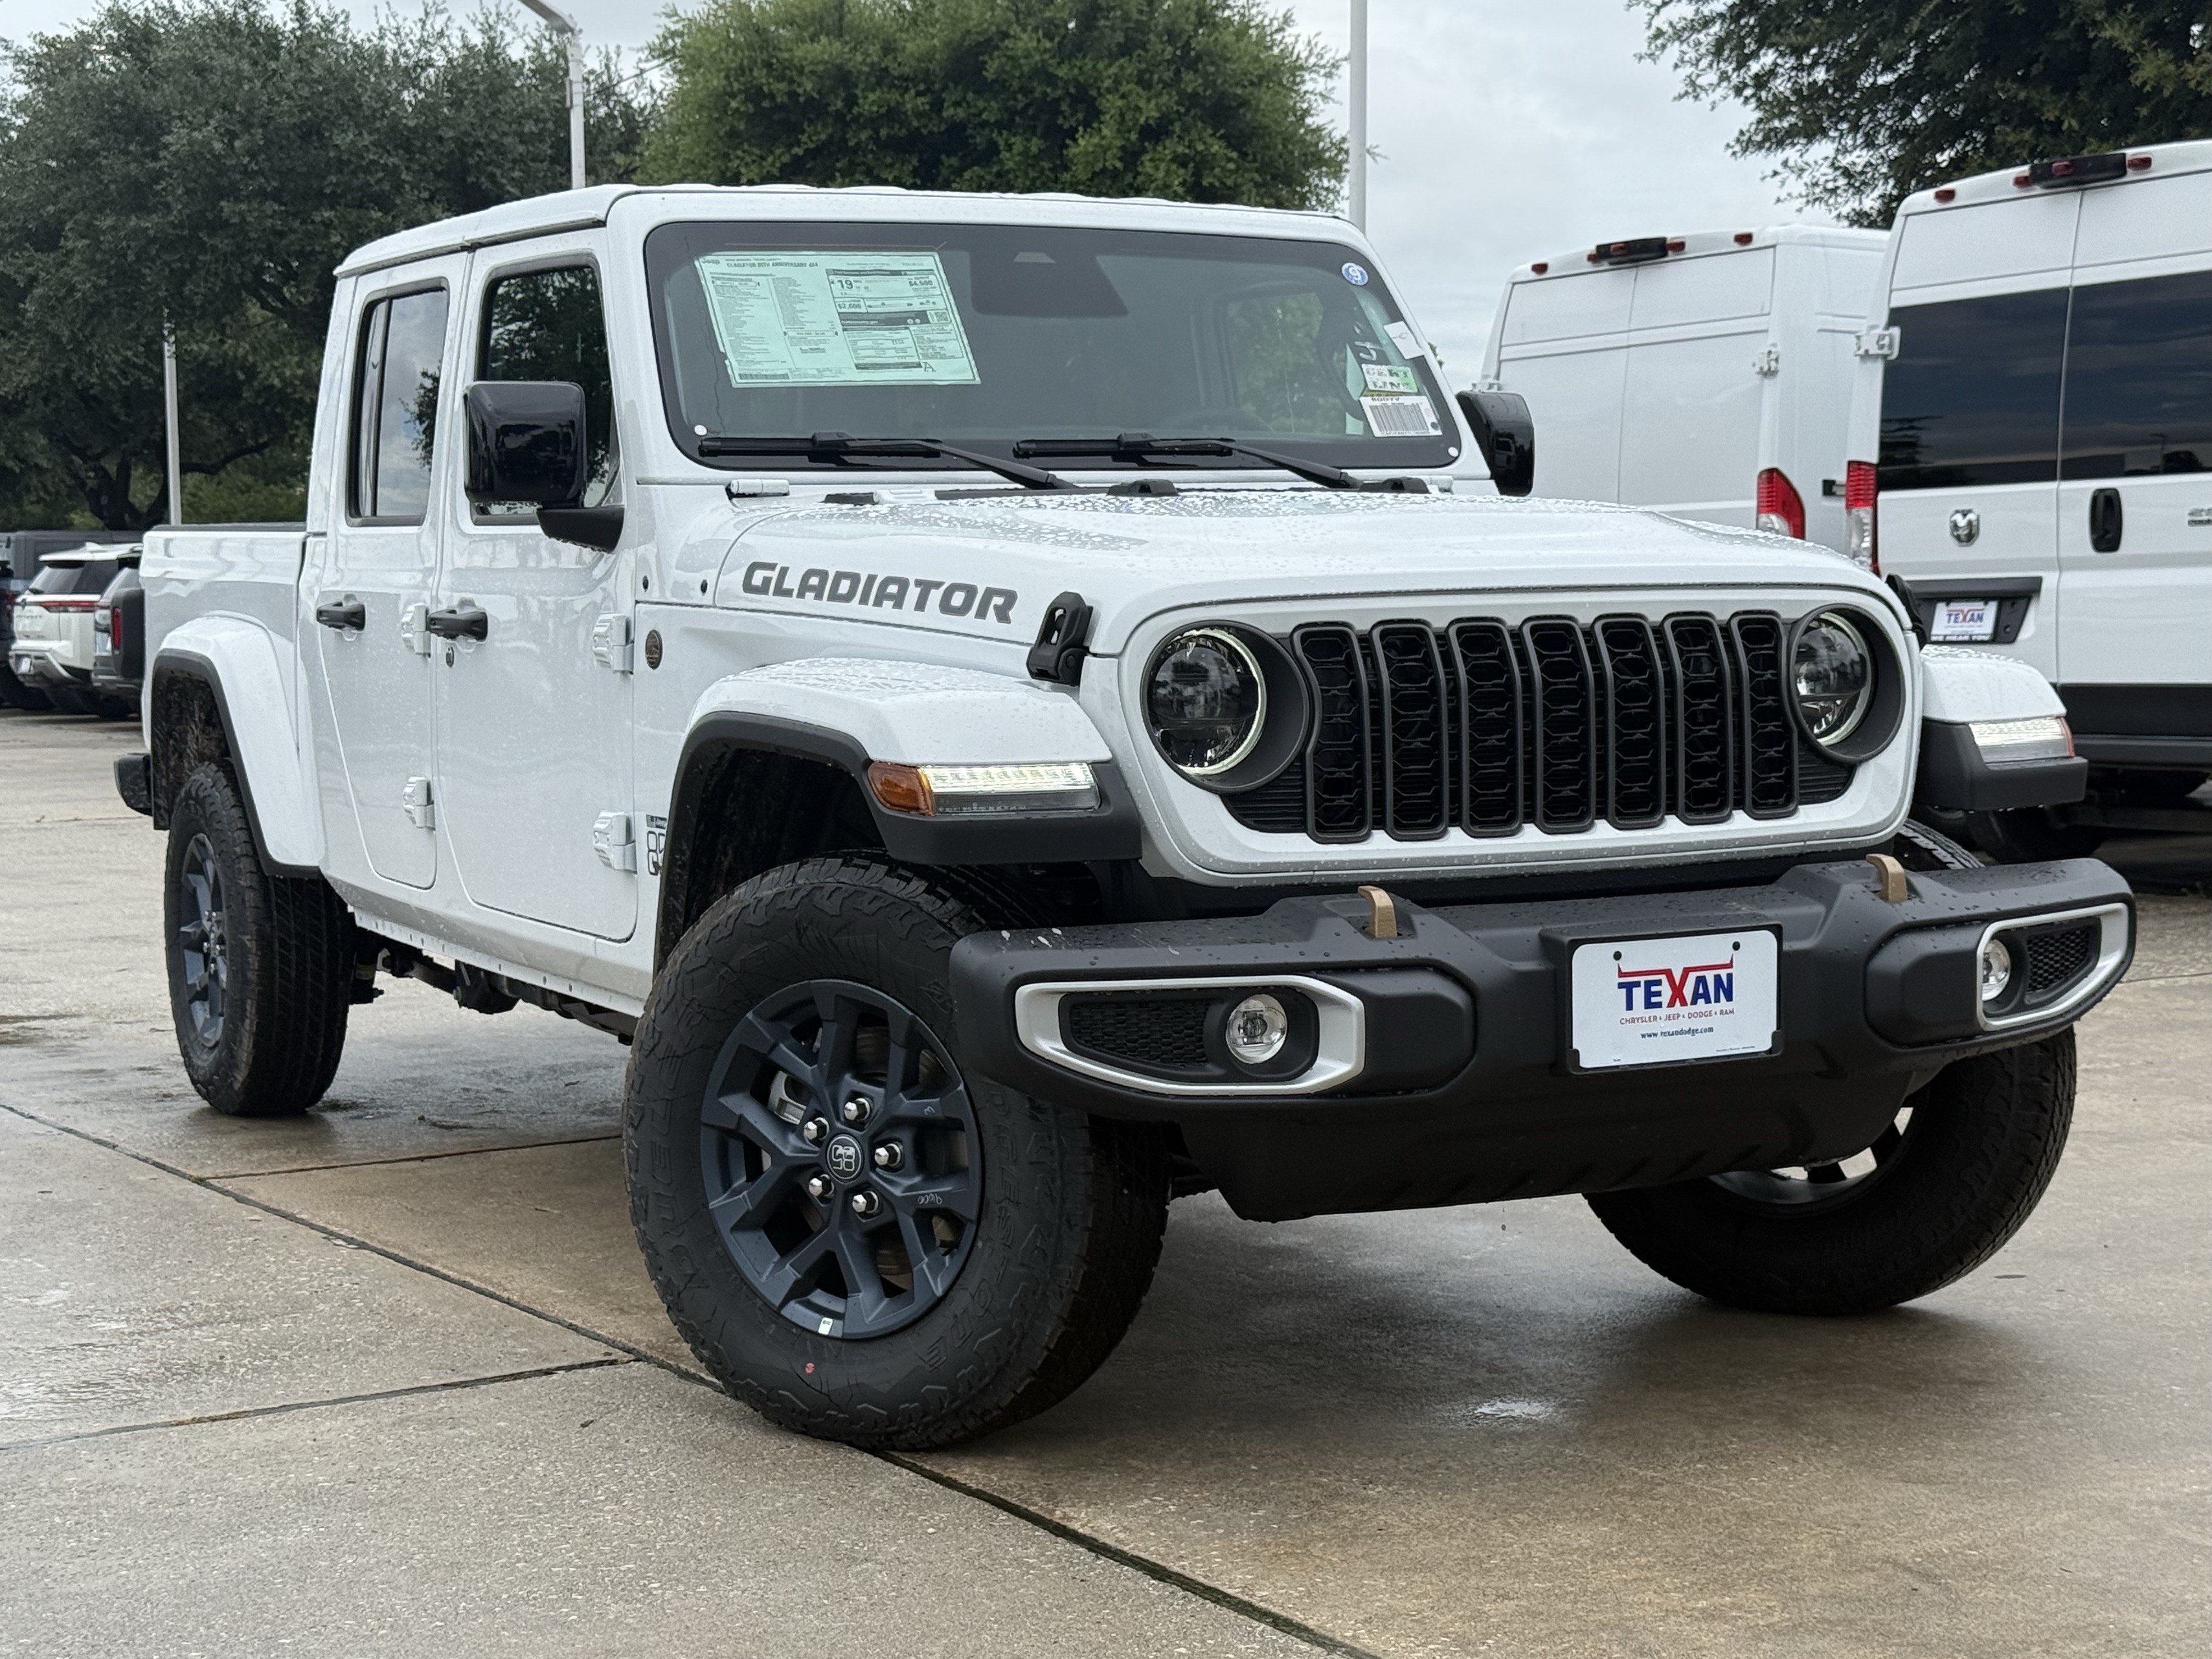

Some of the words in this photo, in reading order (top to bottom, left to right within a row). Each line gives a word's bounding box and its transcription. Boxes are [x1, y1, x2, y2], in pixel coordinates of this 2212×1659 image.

[837, 279, 853, 290] 19
[742, 561, 1019, 624] GLADIATOR
[1946, 608, 1985, 624] TEXAN
[1617, 953, 1734, 1012] TEXAN
[1620, 1015, 1657, 1025] CHRYSLER
[1663, 1013, 1681, 1022] JEEP
[1687, 1009, 1713, 1019] DODGE
[1719, 1007, 1735, 1015] RAM
